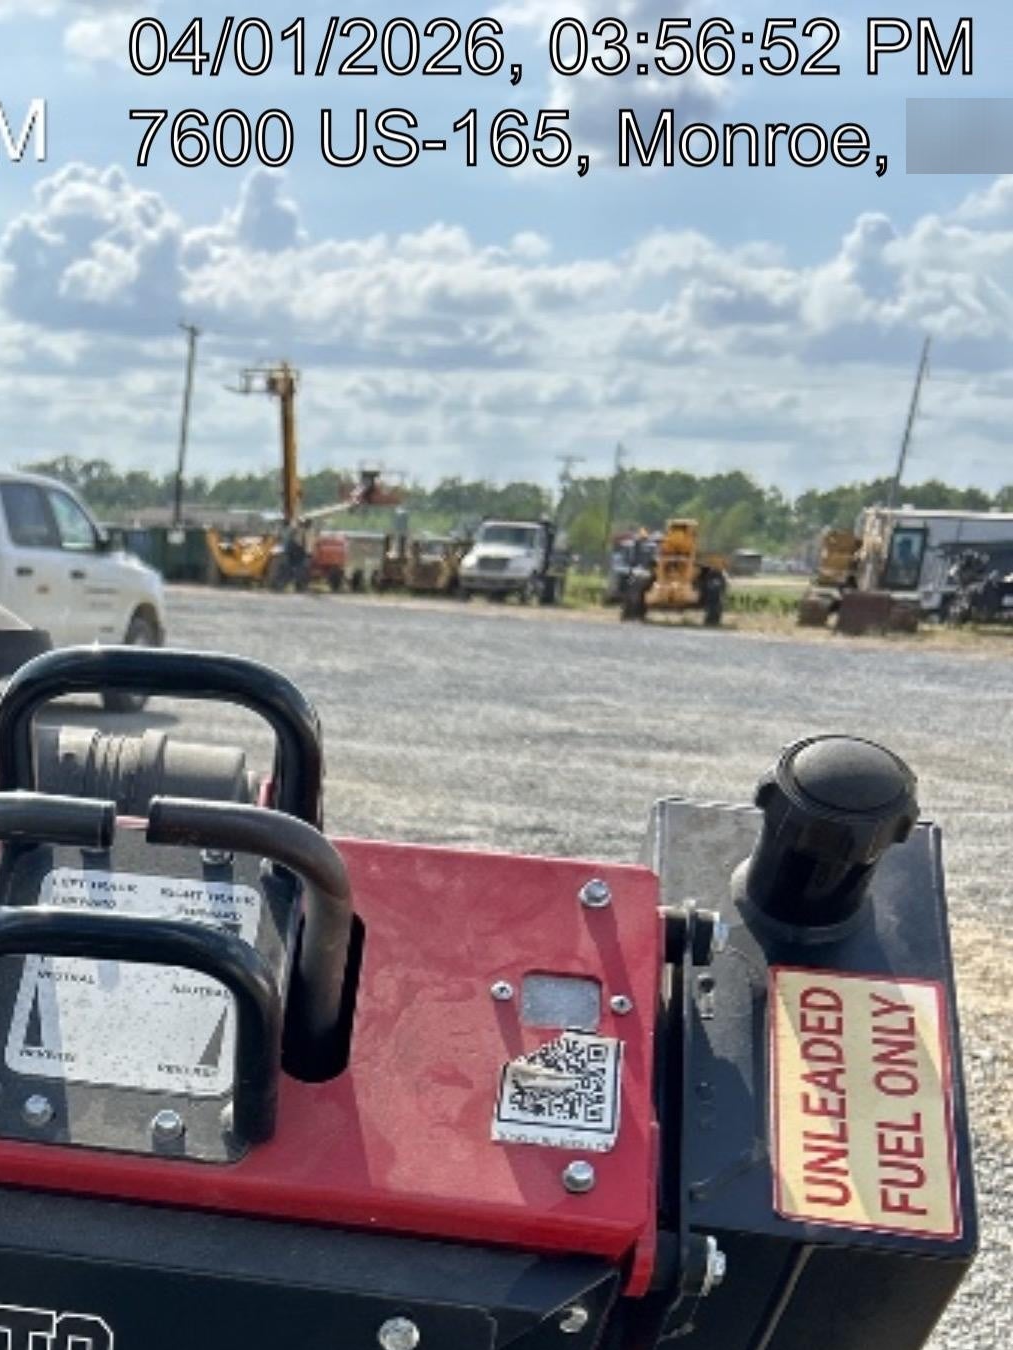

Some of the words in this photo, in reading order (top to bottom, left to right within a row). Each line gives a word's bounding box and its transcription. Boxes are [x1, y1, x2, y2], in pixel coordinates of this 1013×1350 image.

[799, 985, 852, 1208] UNLEADED
[871, 992, 920, 1098] ONLY
[877, 1111, 928, 1216] FUEL
